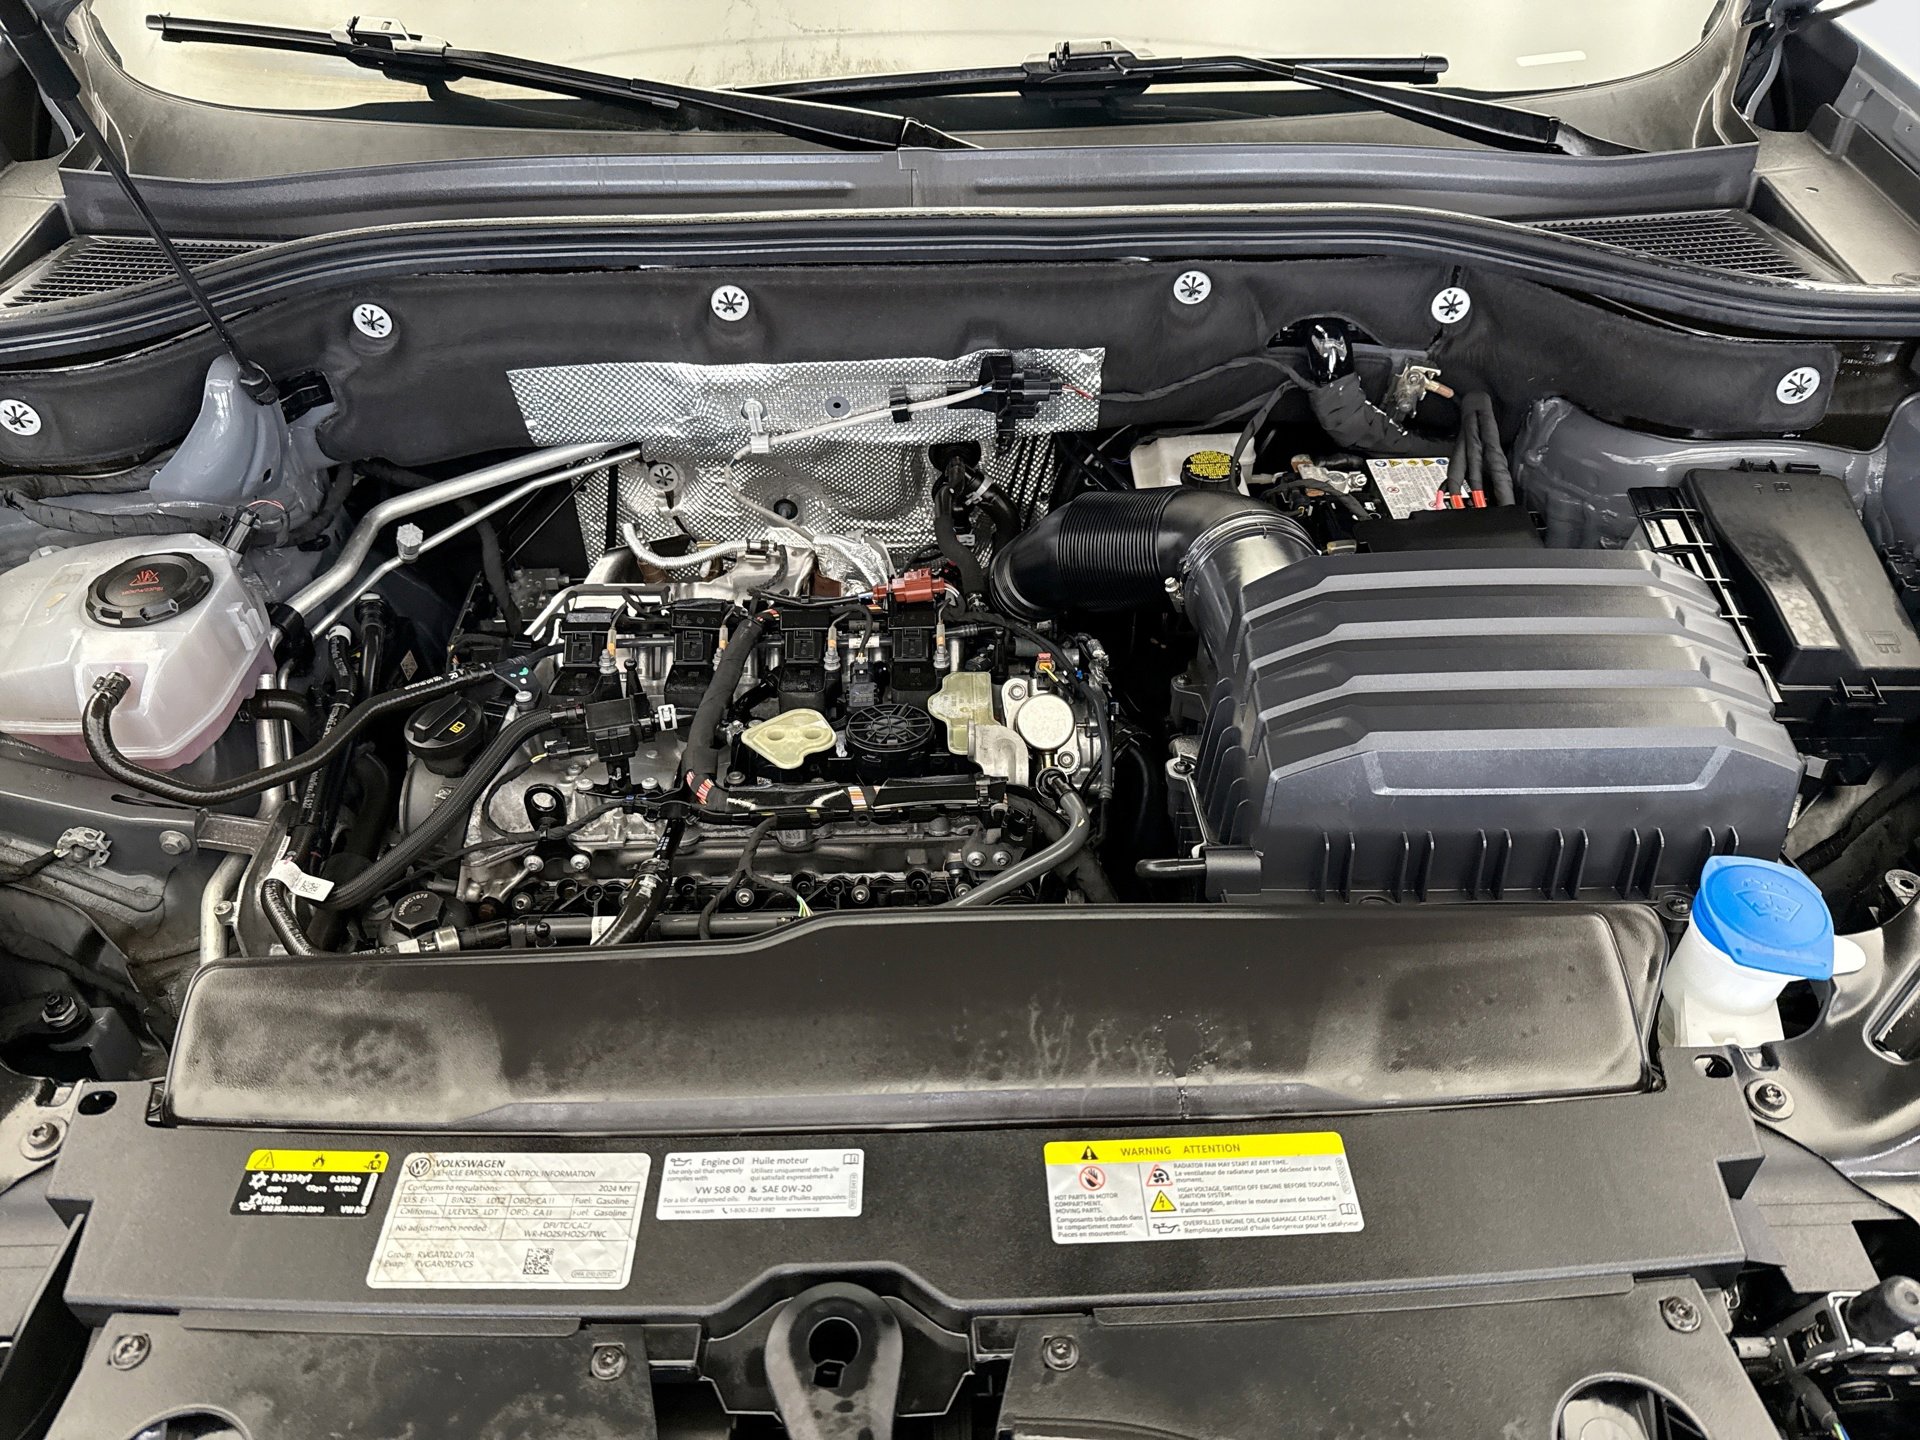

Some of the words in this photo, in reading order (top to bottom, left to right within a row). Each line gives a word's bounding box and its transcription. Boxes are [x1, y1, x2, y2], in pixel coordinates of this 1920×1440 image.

[1120, 1146, 1171, 1156] WARNING
[1183, 1144, 1241, 1154] ATTENTION
[435, 1160, 505, 1168] VOLKSWAGEN
[702, 1158, 730, 1167] Engine
[733, 1157, 745, 1165] Oil
[752, 1157, 775, 1165] Huile
[695, 1186, 712, 1194] VW
[714, 1185, 731, 1194] 508
[733, 1185, 746, 1193] 00
[762, 1185, 779, 1193] SAE
[781, 1184, 812, 1193] 0W-20
